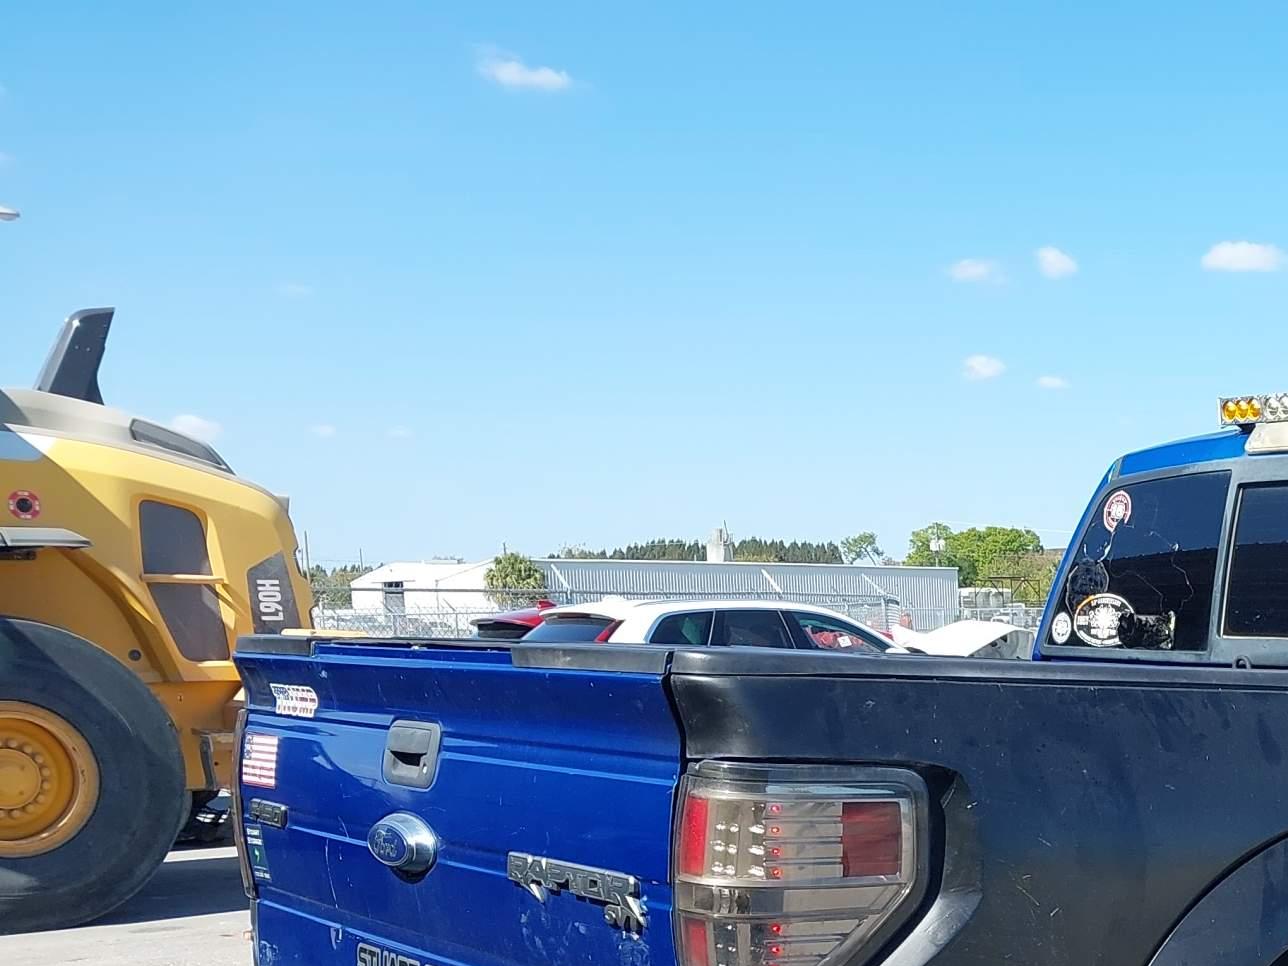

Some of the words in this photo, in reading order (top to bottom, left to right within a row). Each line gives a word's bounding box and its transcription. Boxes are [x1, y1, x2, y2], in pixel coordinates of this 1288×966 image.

[256, 579, 284, 621] L90H
[374, 829, 400, 858] Ford
[508, 851, 645, 920] RAPTOR
